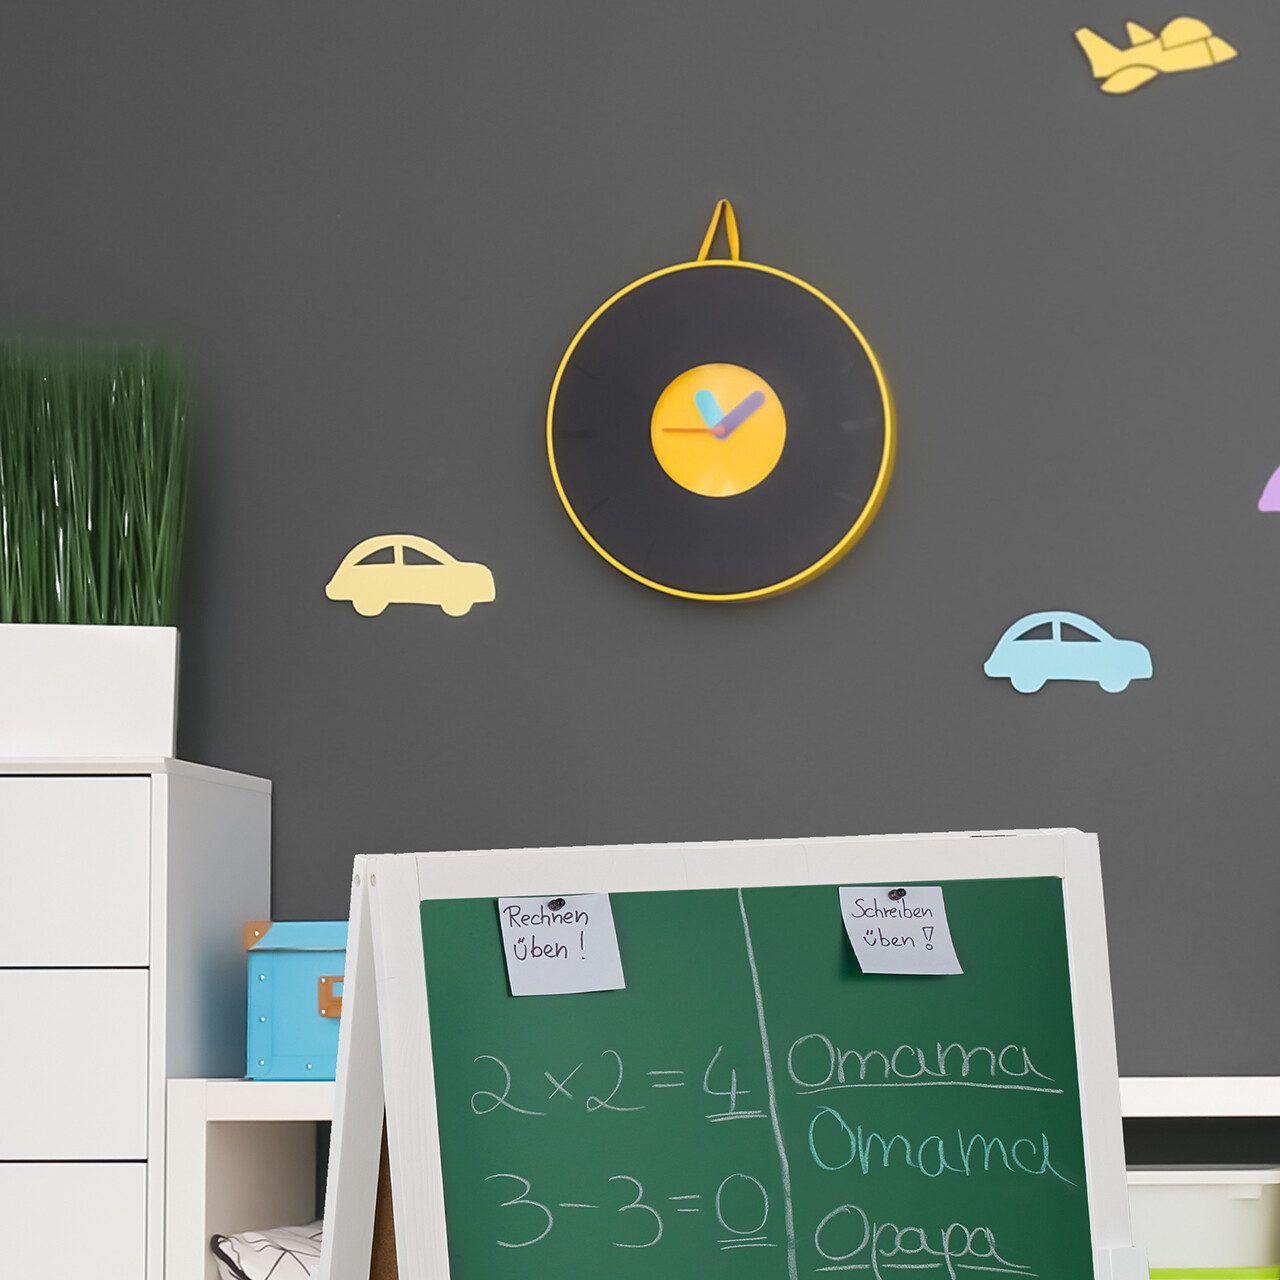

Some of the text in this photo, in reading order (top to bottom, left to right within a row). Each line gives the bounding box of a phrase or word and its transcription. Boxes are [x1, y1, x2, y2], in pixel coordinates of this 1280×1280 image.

[503, 904, 589, 928] Rechnen
[851, 897, 933, 919] Schreiben
[787, 1033, 1056, 1087] Omama
[808, 1105, 1079, 1187] Omama
